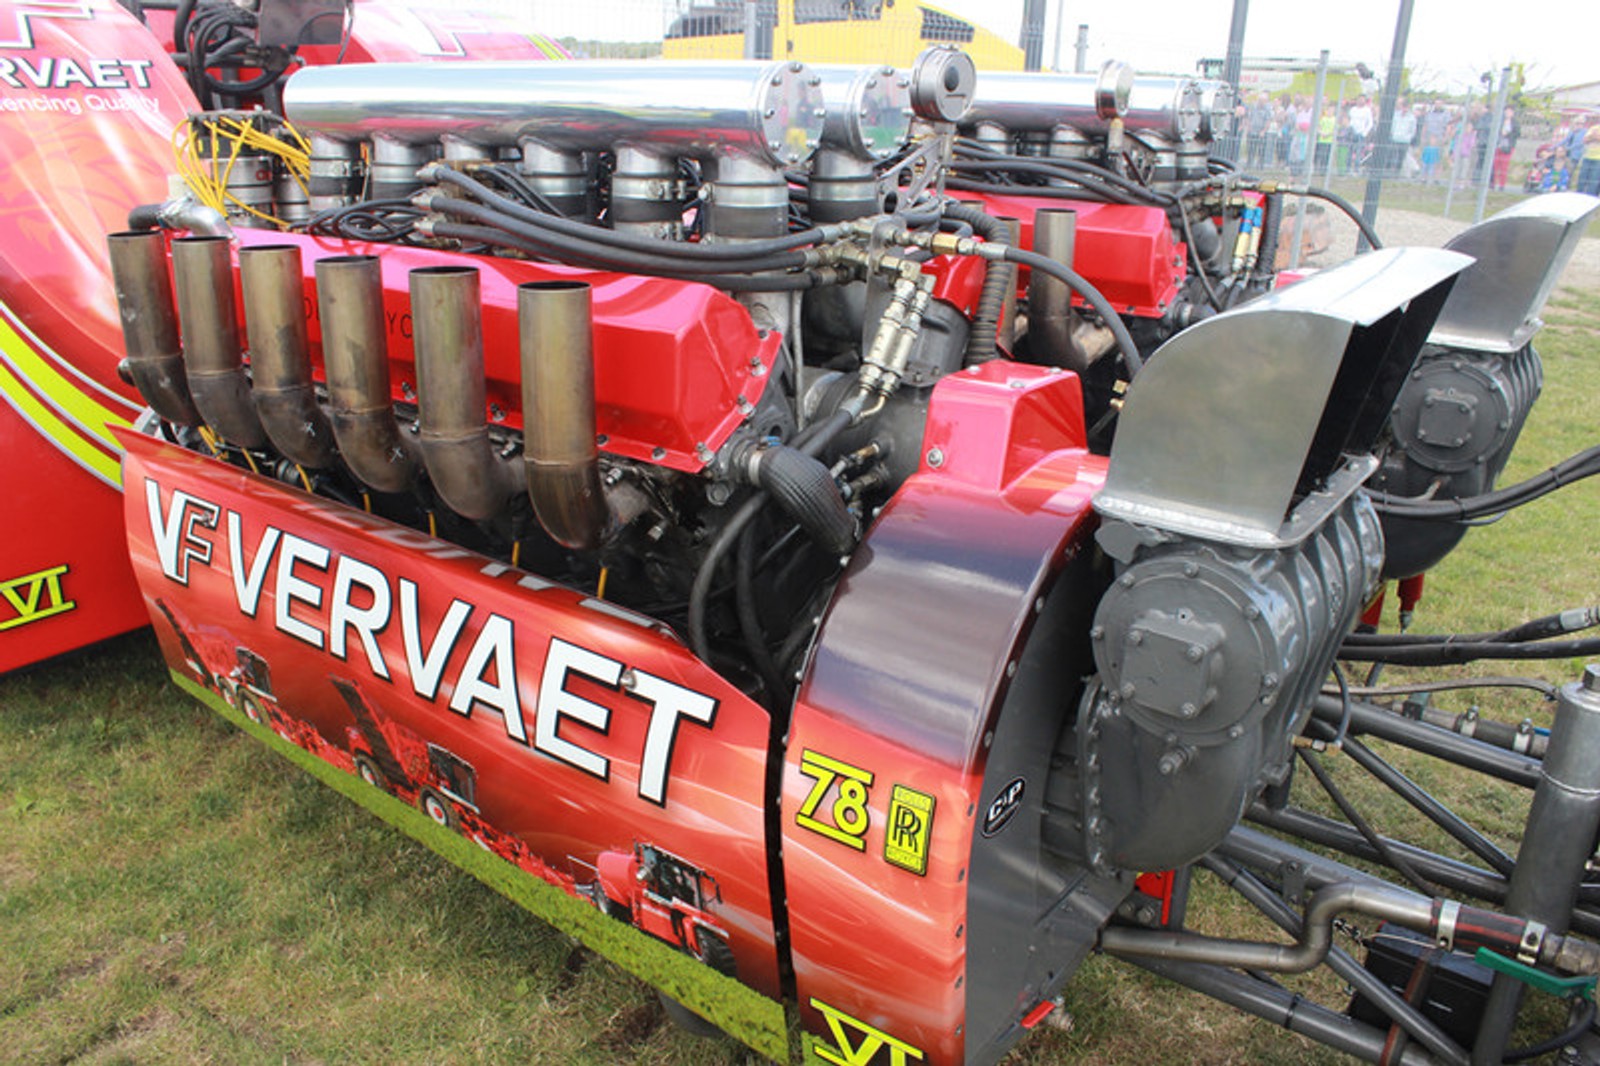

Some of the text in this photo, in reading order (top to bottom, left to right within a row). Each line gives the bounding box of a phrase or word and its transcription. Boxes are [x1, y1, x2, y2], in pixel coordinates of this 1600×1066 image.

[0, 95, 82, 115] encing
[145, 477, 220, 587] VF
[227, 509, 720, 808] VERVAET
[796, 750, 873, 851] 78
